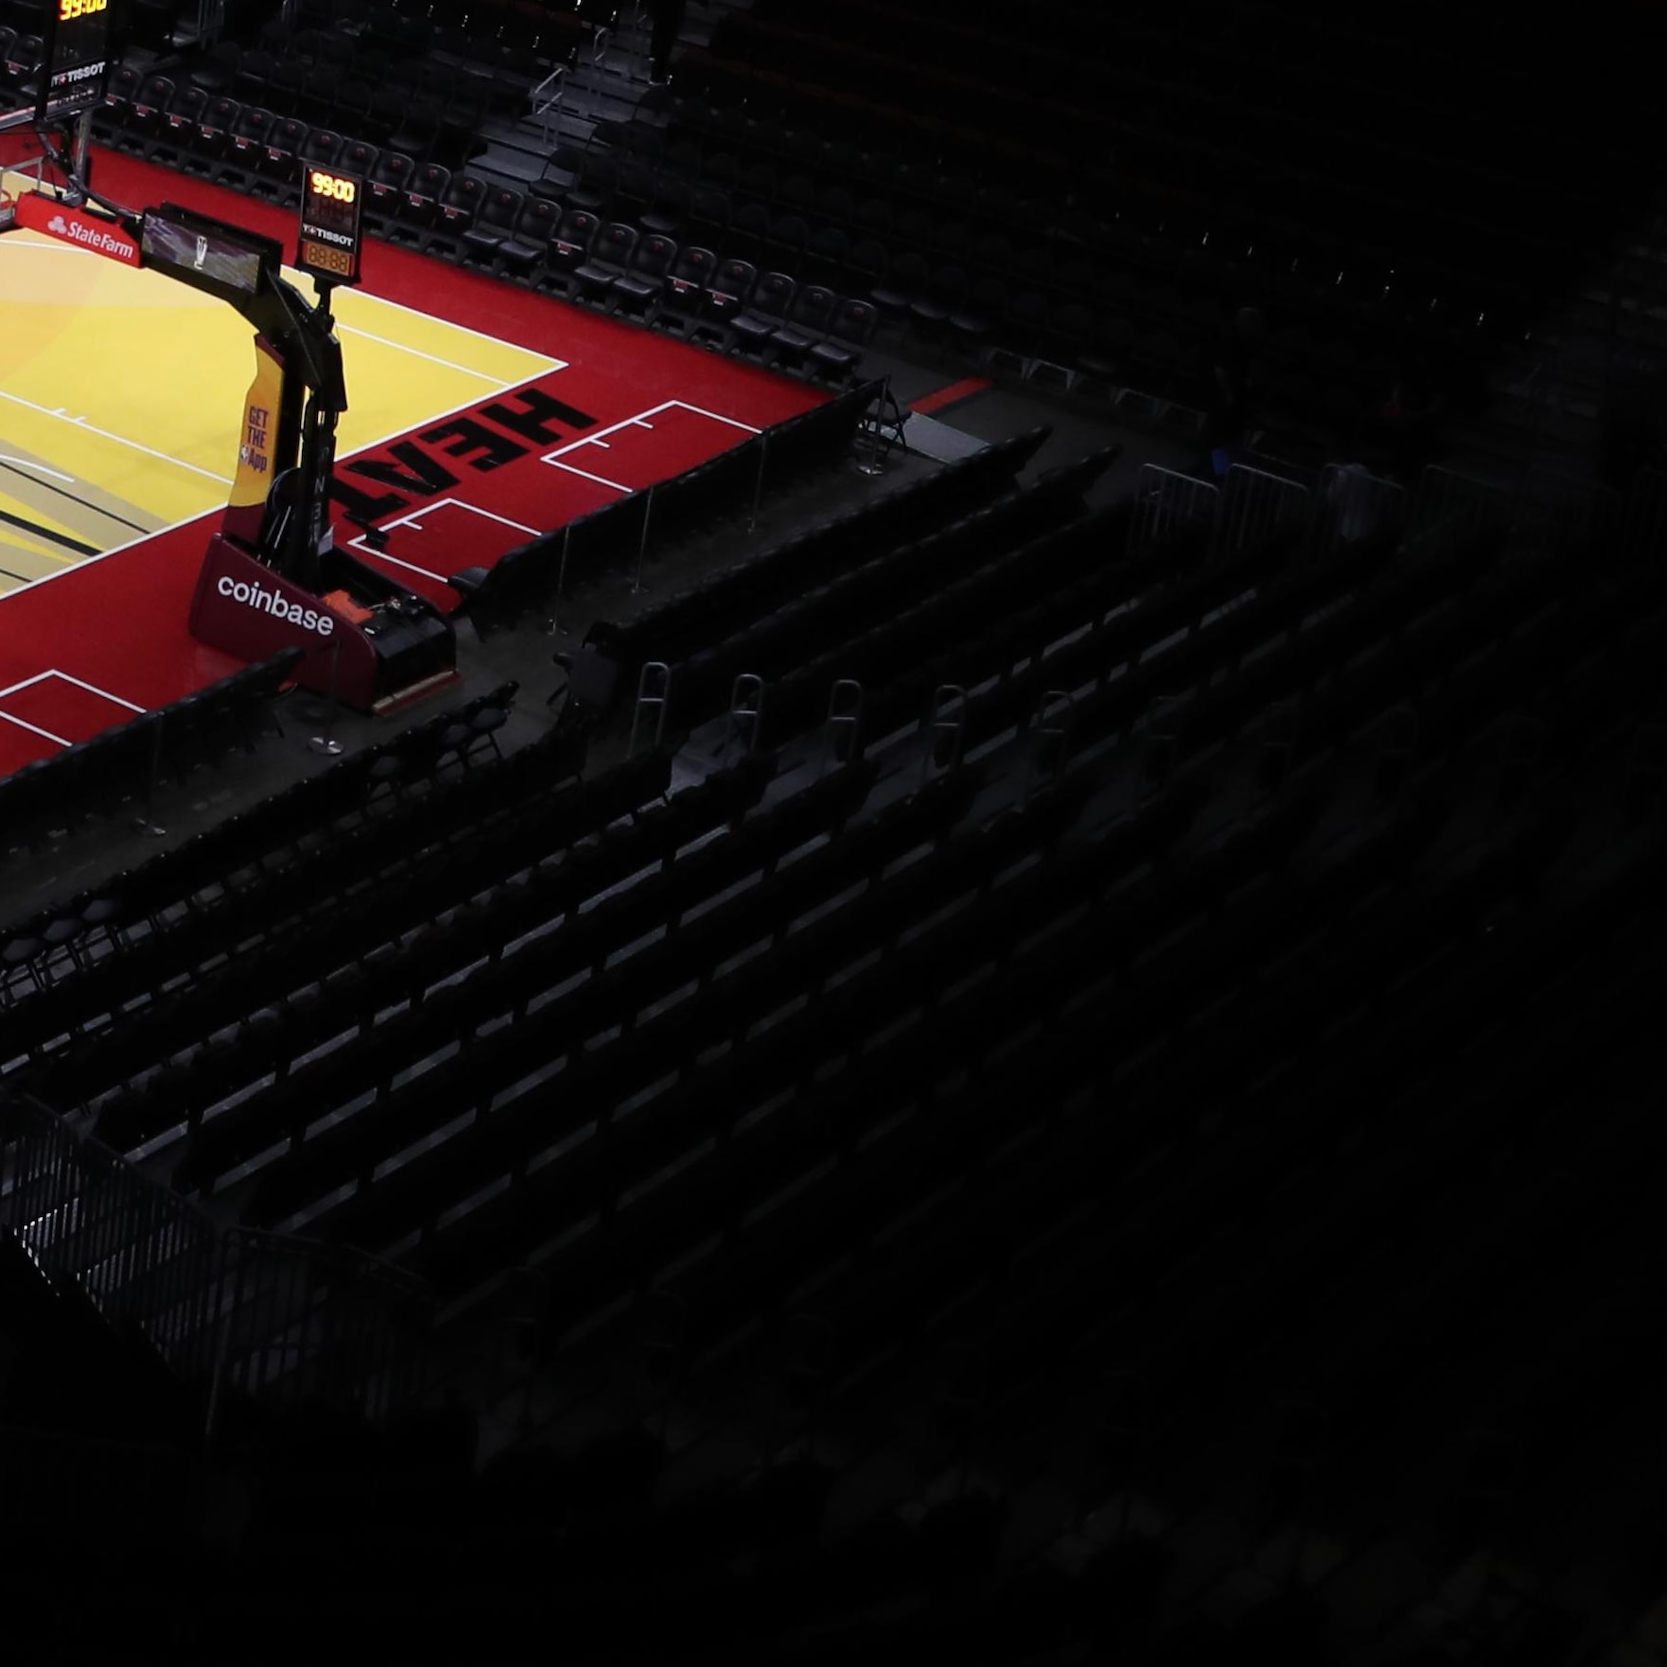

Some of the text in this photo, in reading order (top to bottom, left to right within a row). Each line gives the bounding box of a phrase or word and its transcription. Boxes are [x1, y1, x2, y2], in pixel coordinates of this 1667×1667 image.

[67, 61, 106, 83] TISSOT
[310, 172, 355, 204] 99:00
[317, 228, 354, 247] TISSOT
[249, 406, 268, 428] GET
[248, 427, 266, 449] THE
[217, 575, 335, 636] coinbase
